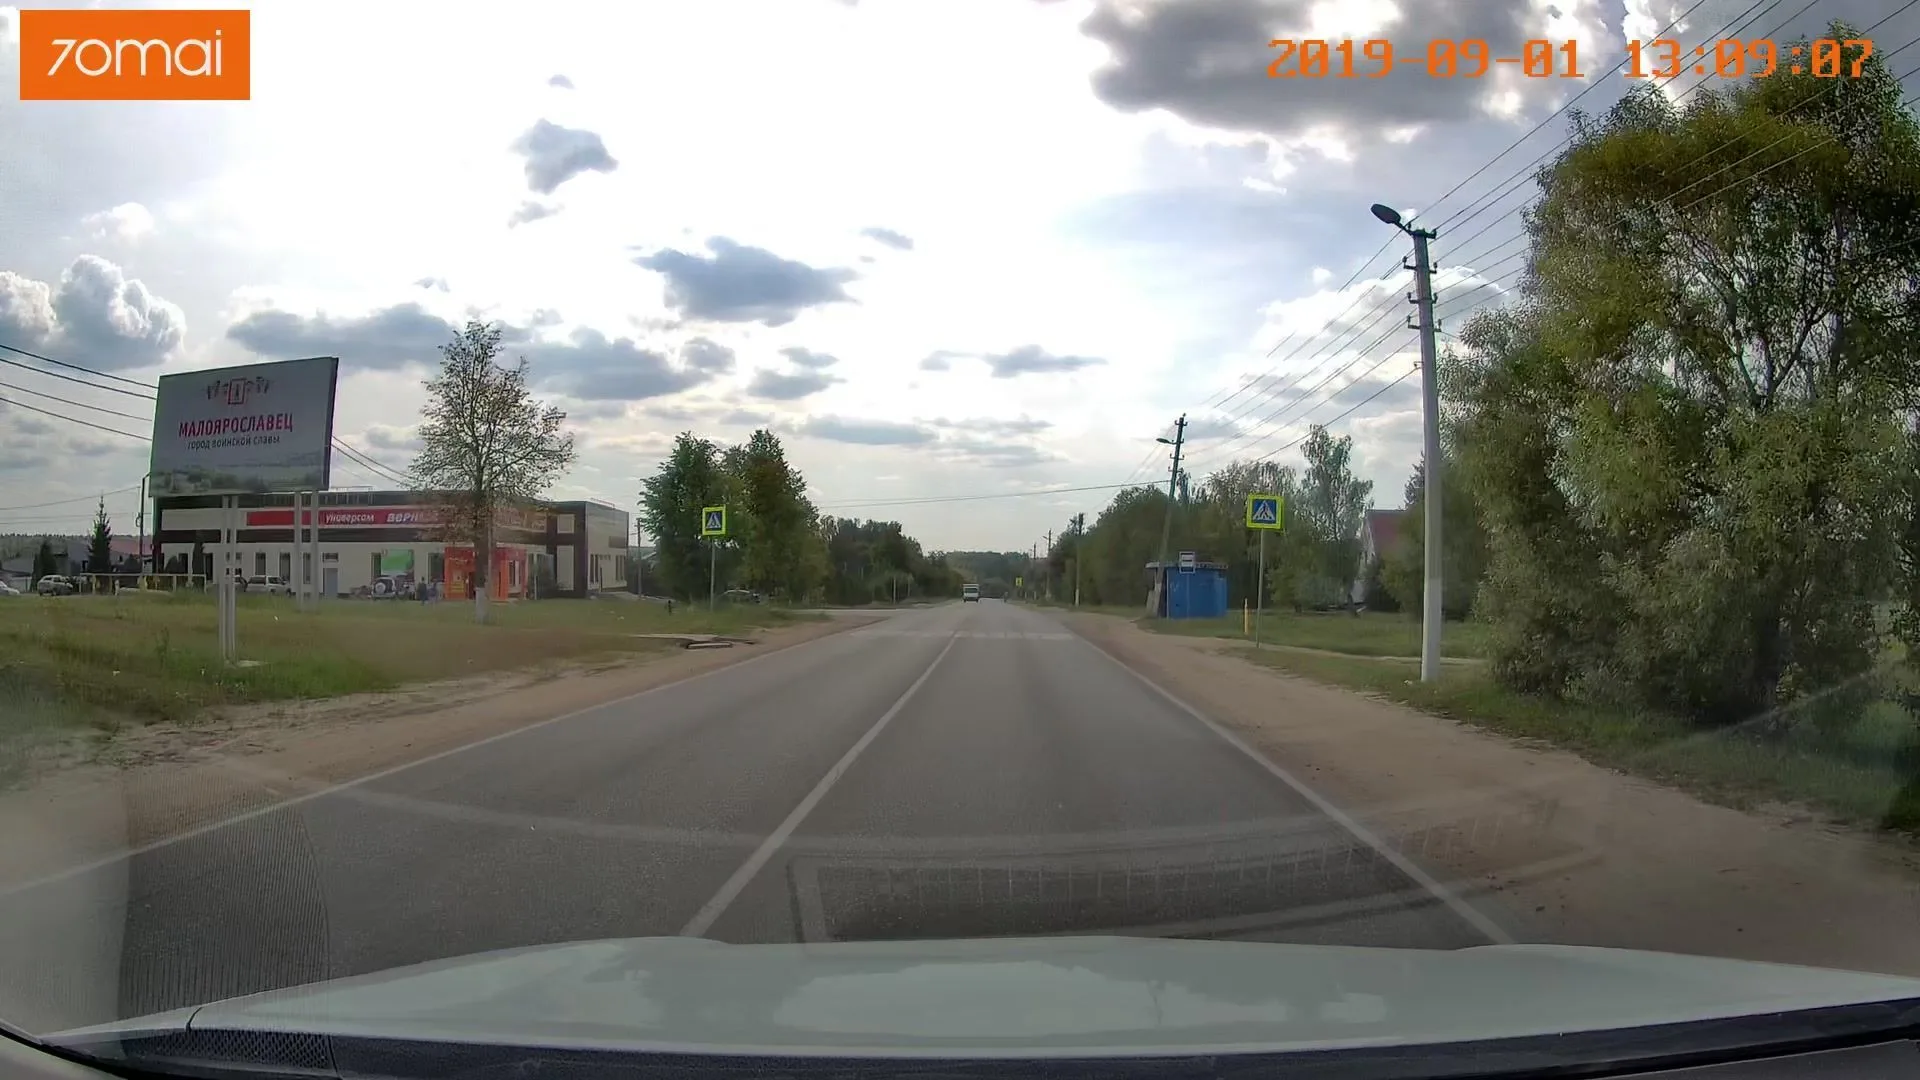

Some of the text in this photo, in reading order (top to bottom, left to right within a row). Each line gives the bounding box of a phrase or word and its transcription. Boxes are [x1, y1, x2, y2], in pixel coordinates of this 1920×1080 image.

[178, 412, 294, 438] МАЛОЯРОСЛАВЕЦ
[186, 435, 280, 452] город воинской славы
